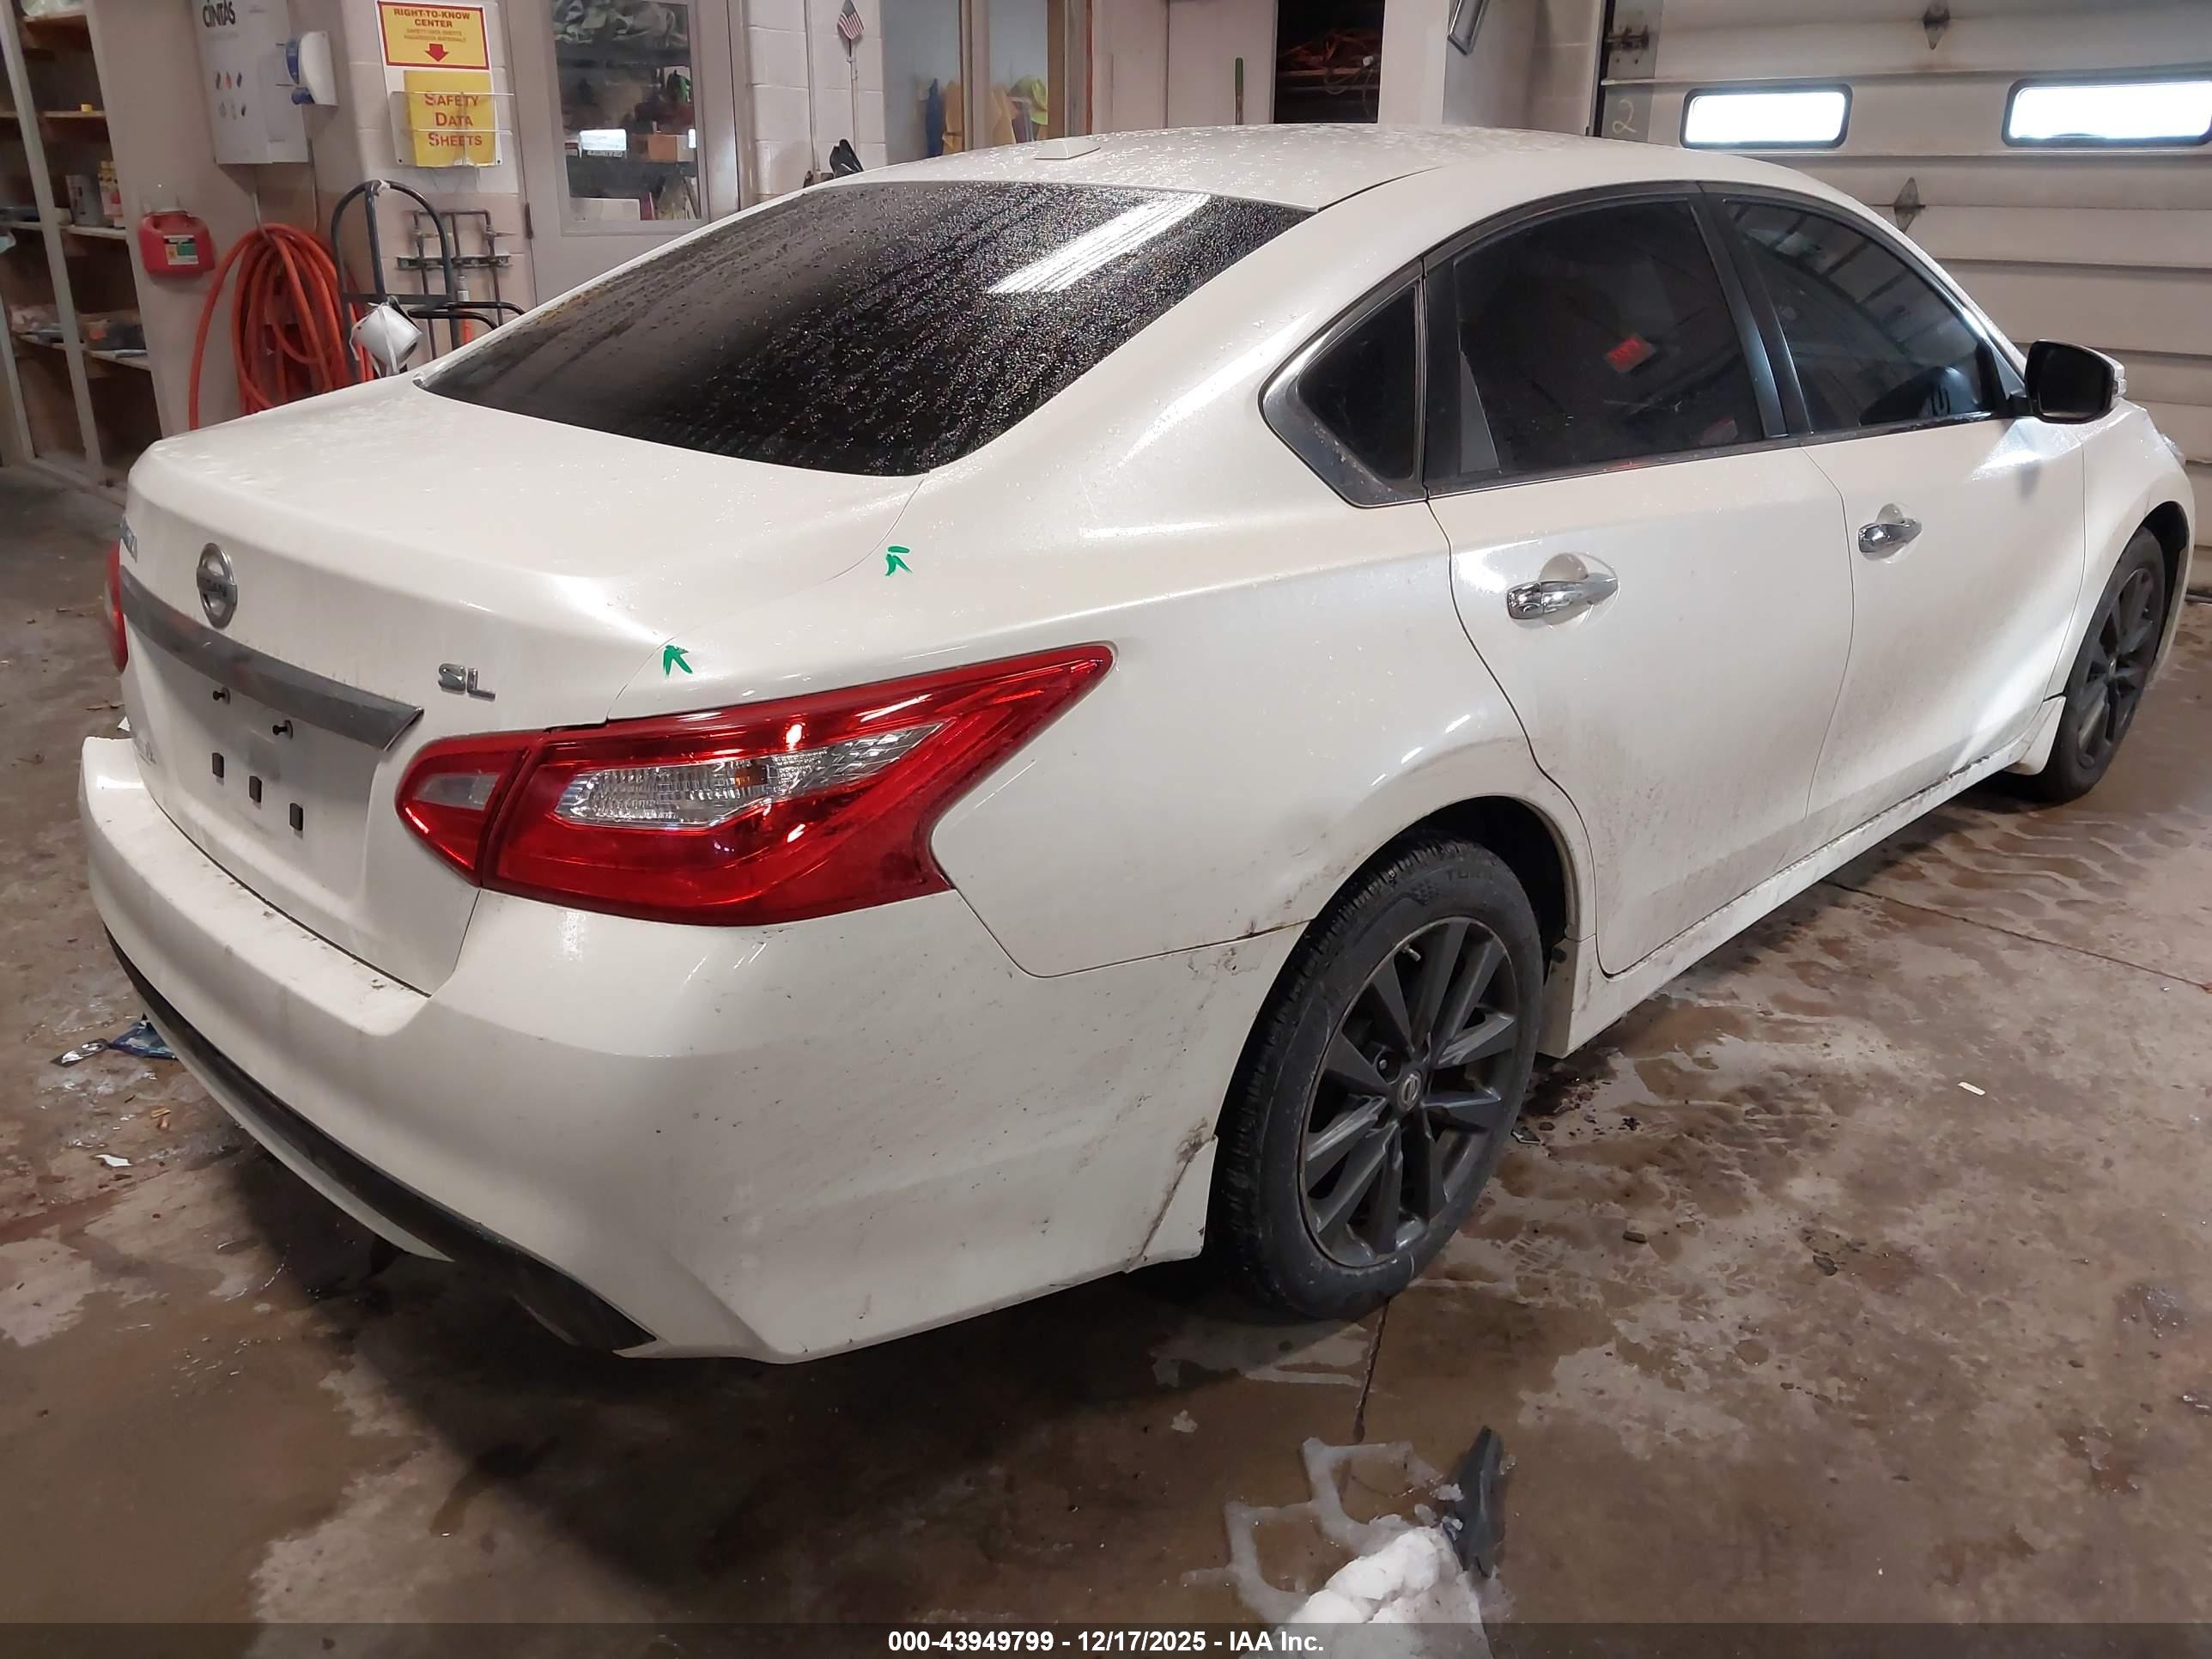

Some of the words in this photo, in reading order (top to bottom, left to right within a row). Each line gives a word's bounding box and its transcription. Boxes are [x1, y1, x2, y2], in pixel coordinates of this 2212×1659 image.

[393, 8, 471, 21] RIGHT-TO-KNOW
[414, 18, 453, 28] CENTER
[424, 92, 479, 106] SAFETY
[434, 112, 474, 127] DATA
[1612, 99, 1637, 135] 2
[428, 131, 483, 147] SHEETS
[437, 662, 496, 702] SL
